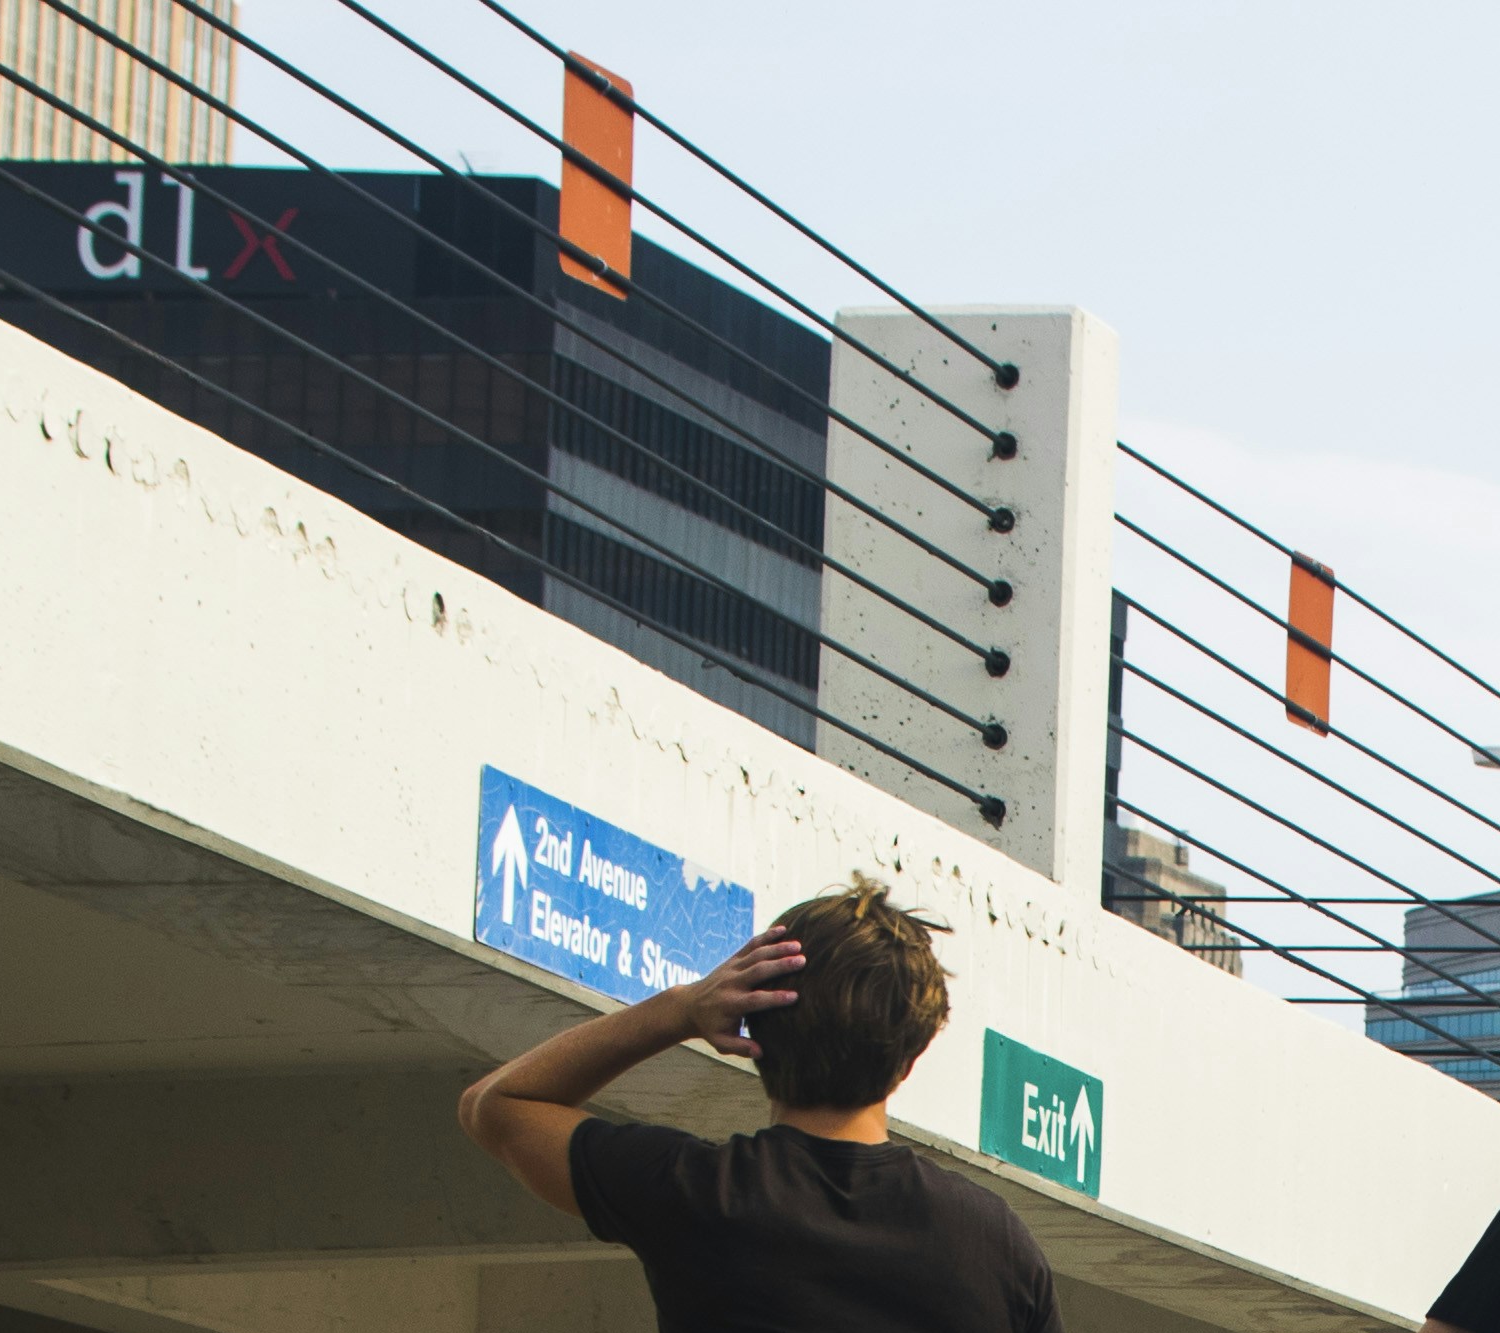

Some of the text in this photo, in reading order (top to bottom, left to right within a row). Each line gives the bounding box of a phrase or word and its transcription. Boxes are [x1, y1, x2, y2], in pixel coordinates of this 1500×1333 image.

[77, 170, 299, 282] dlx
[534, 816, 649, 911] 2nd Avenue
[531, 889, 611, 967] Elevator
[617, 929, 633, 978] &
[1022, 1081, 1067, 1162] Exit
